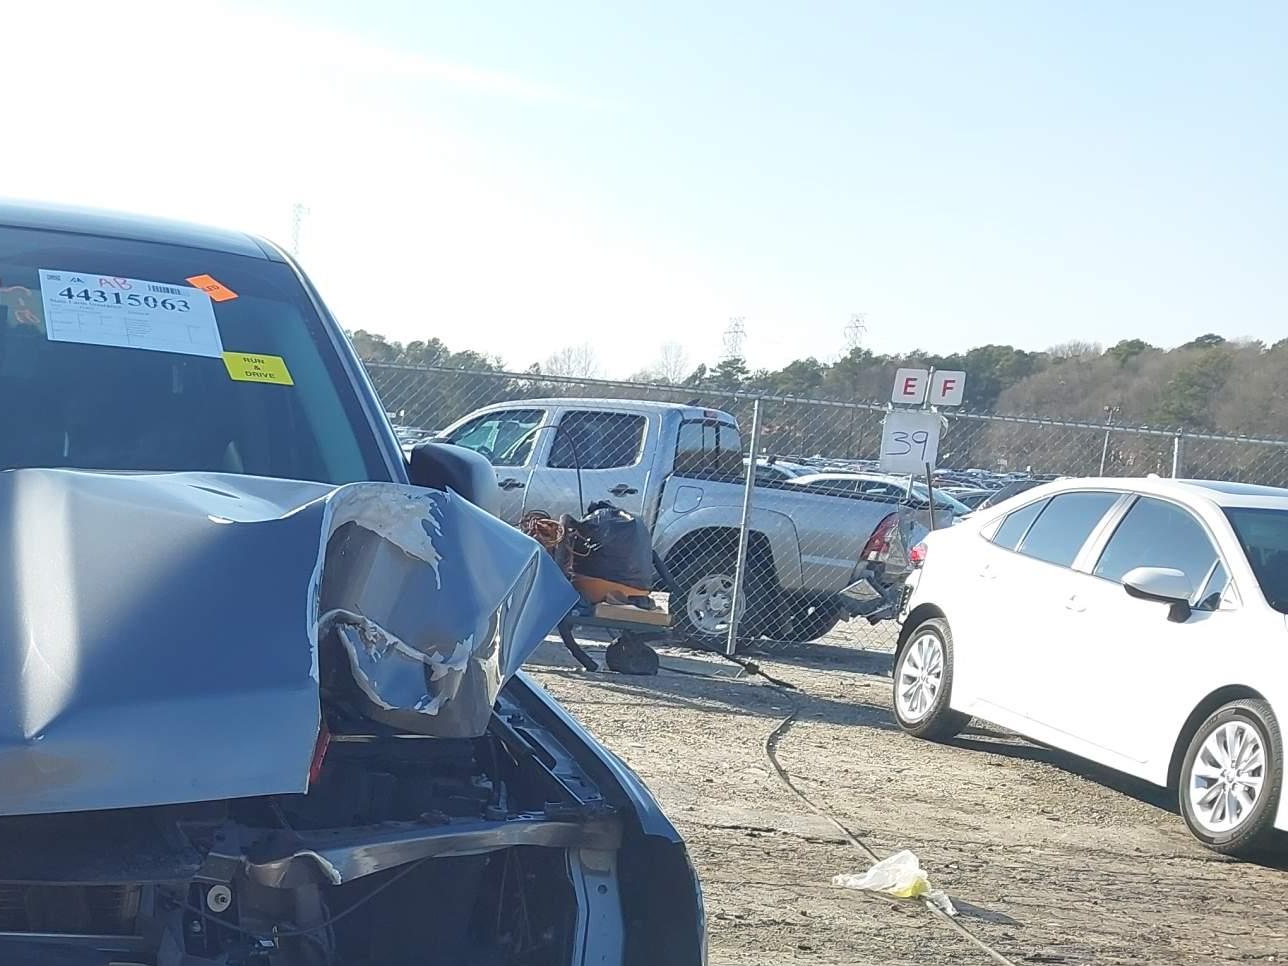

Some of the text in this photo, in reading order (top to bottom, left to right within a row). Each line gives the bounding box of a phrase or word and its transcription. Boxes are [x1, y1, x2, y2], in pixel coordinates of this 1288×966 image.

[58, 286, 191, 313] 44315063
[242, 357, 265, 365] RUN
[244, 371, 277, 379] DRIVE
[902, 377, 918, 396] E
[941, 379, 956, 397] F
[885, 430, 929, 461] 39
